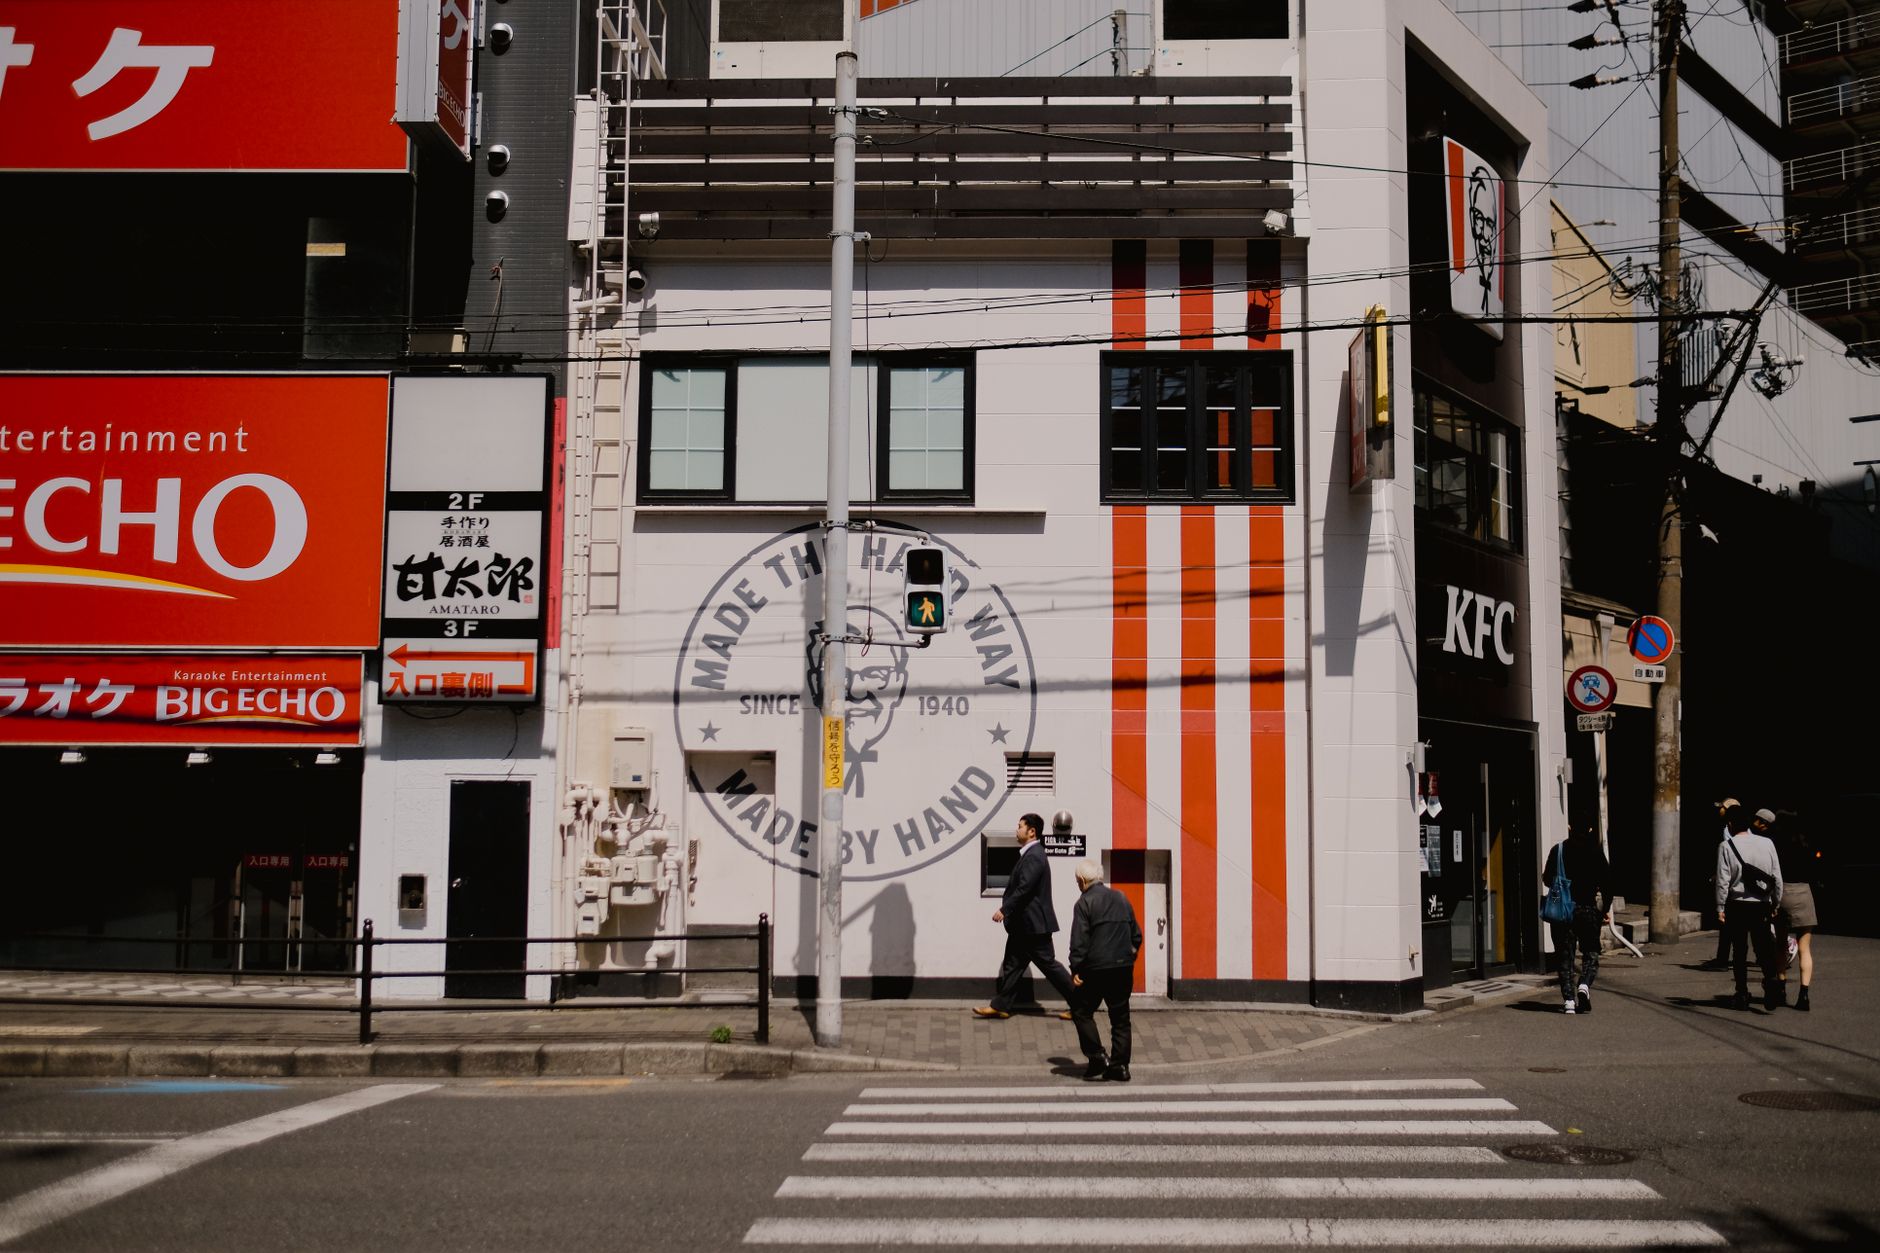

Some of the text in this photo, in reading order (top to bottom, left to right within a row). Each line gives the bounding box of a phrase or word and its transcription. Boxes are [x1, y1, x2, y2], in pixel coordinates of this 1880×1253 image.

[448, 492, 485, 510] 2F
[441, 516, 490, 529] 手作り
[439, 535, 491, 548] 居酒屋
[392, 551, 534, 603] 甘太郎
[429, 604, 500, 615] AMATARO
[691, 577, 769, 691] MADE
[763, 537, 828, 590] TH
[963, 602, 1021, 690] WAY
[443, 619, 479, 637] 3F
[1442, 584, 1515, 665] KFC
[174, 670, 327, 682] Karaoke Entertainment
[385, 671, 493, 698] 入口裏側
[156, 685, 346, 722] BIG ECHO
[739, 693, 970, 716] SINCE 1940
[715, 768, 818, 859] MADE
[893, 765, 996, 857] HAND
[249, 855, 290, 867] 入口専用
[308, 856, 349, 867] 入口専用
